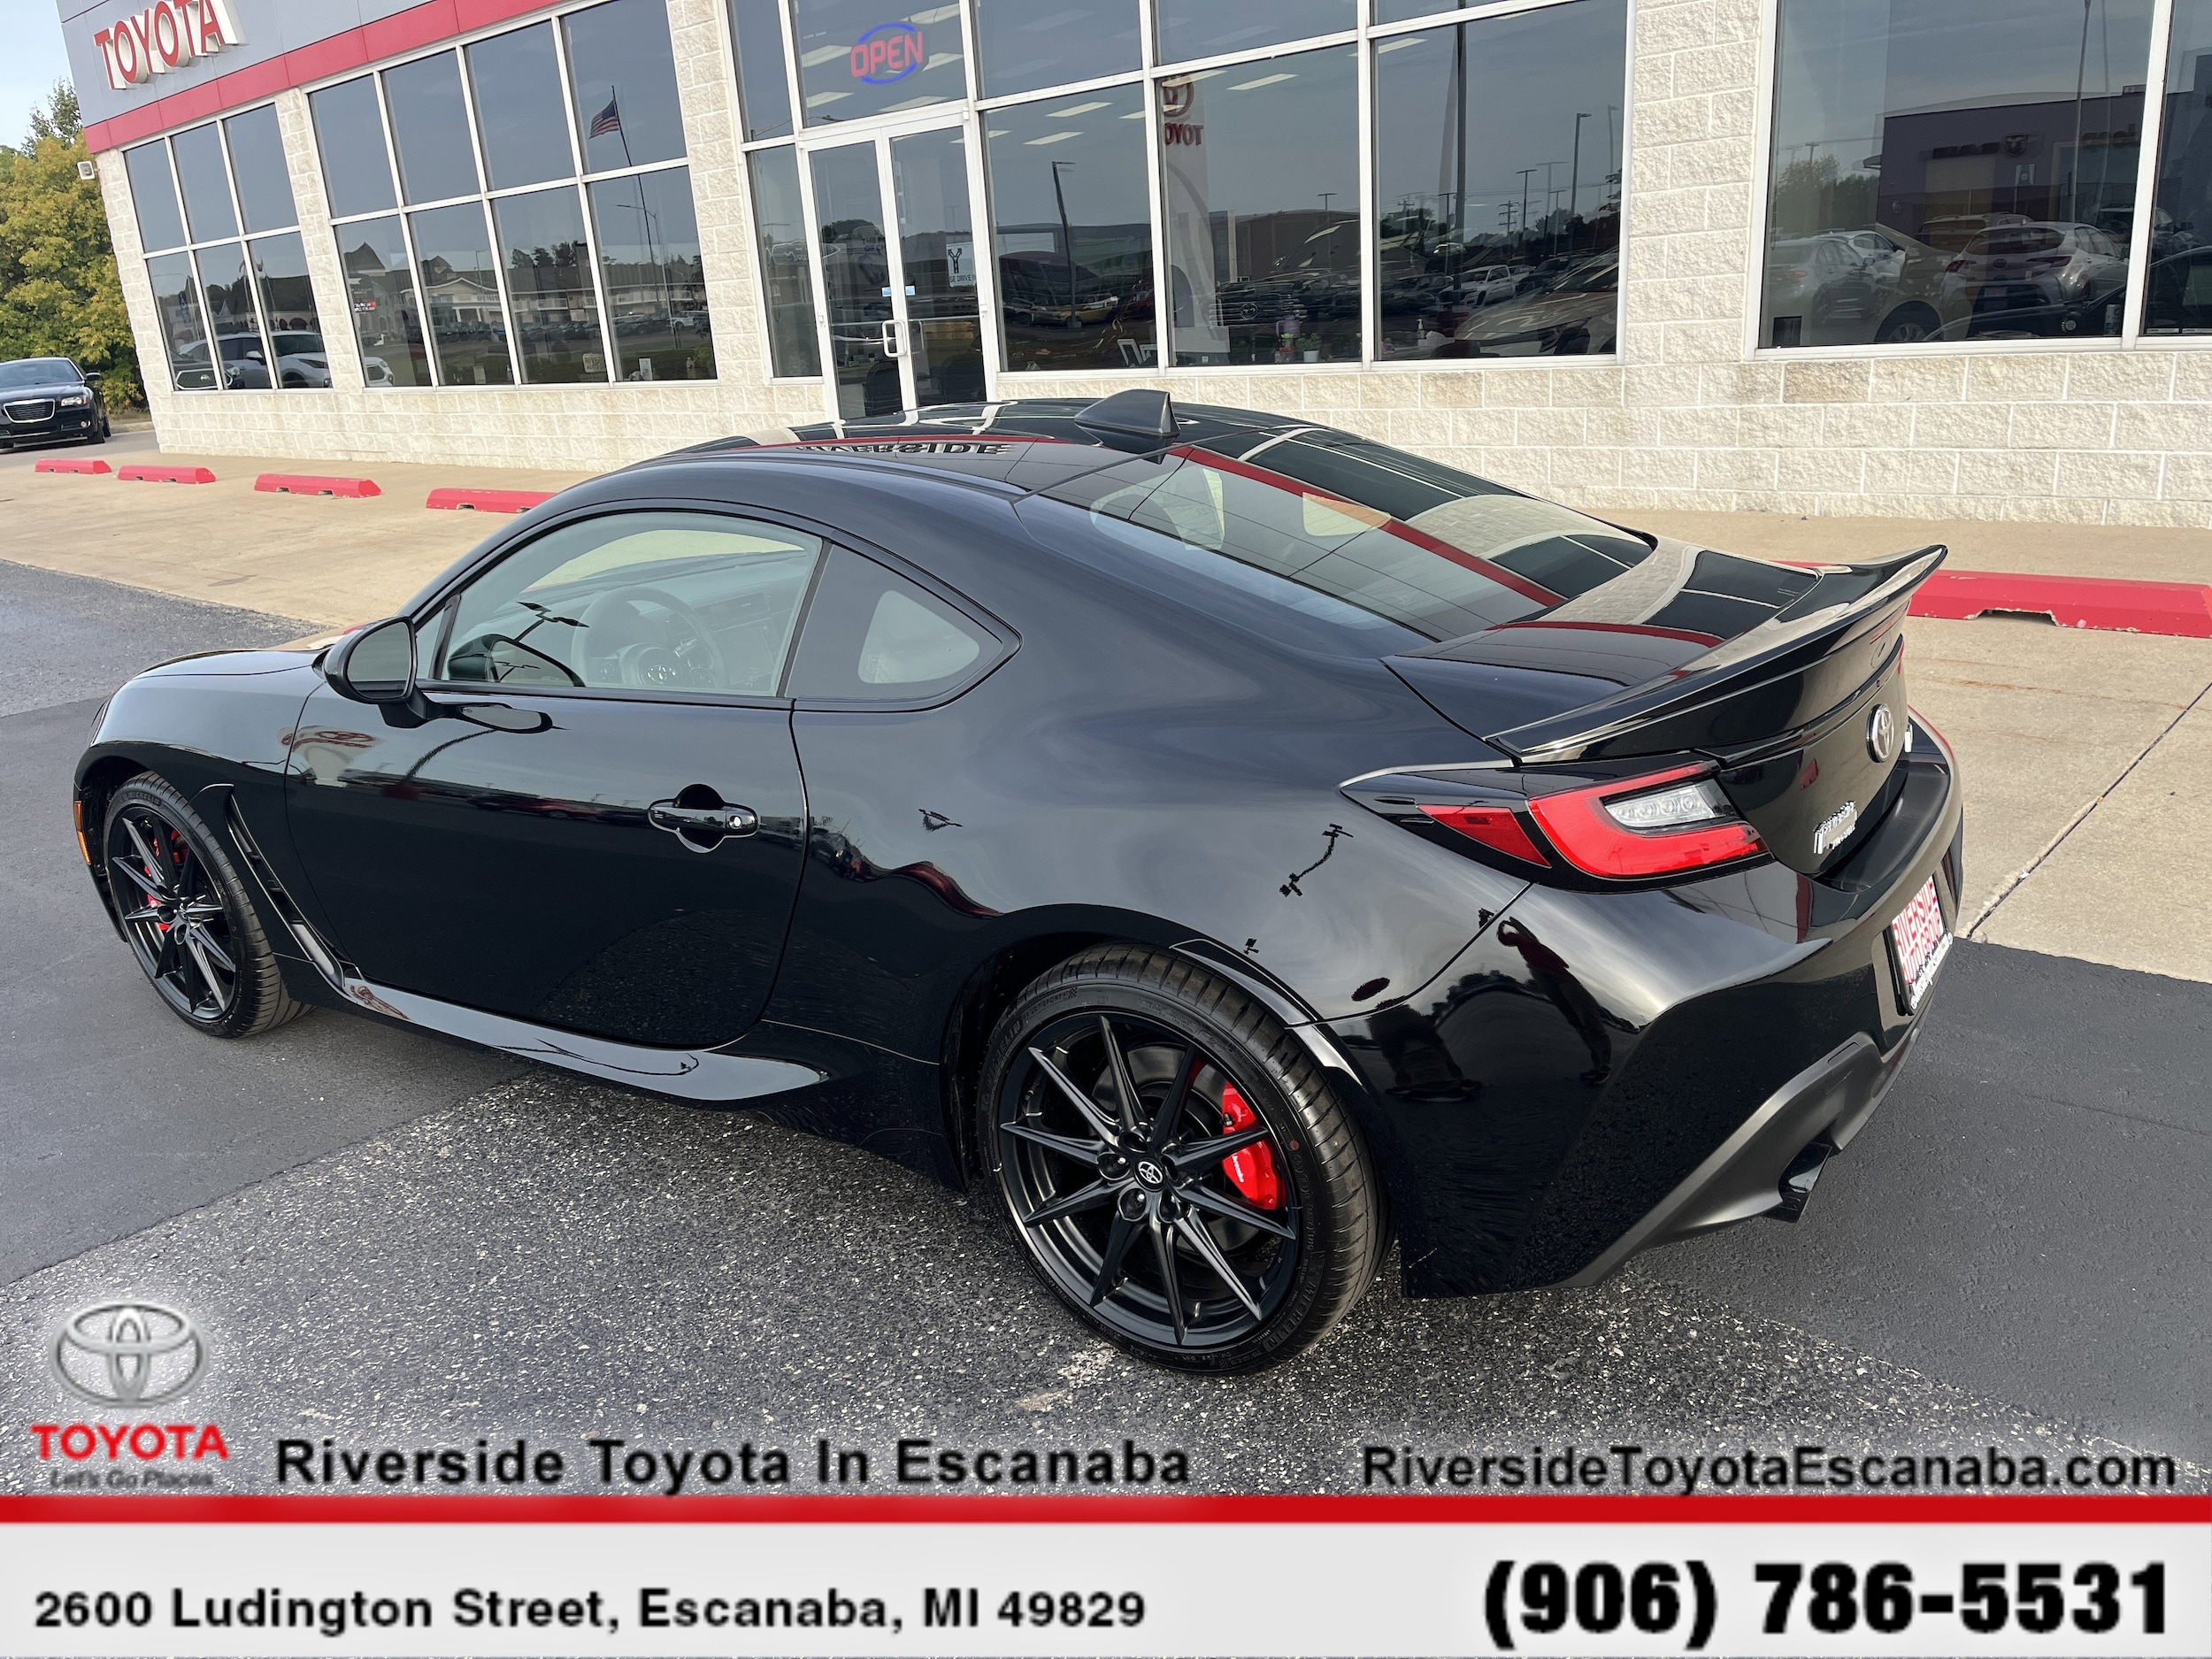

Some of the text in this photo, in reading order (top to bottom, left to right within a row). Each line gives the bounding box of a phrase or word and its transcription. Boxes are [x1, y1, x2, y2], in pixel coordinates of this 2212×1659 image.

[93, 0, 235, 89] TOYOTA
[850, 30, 924, 78] OPEN
[1892, 879, 1939, 957] RIVERSIDE
